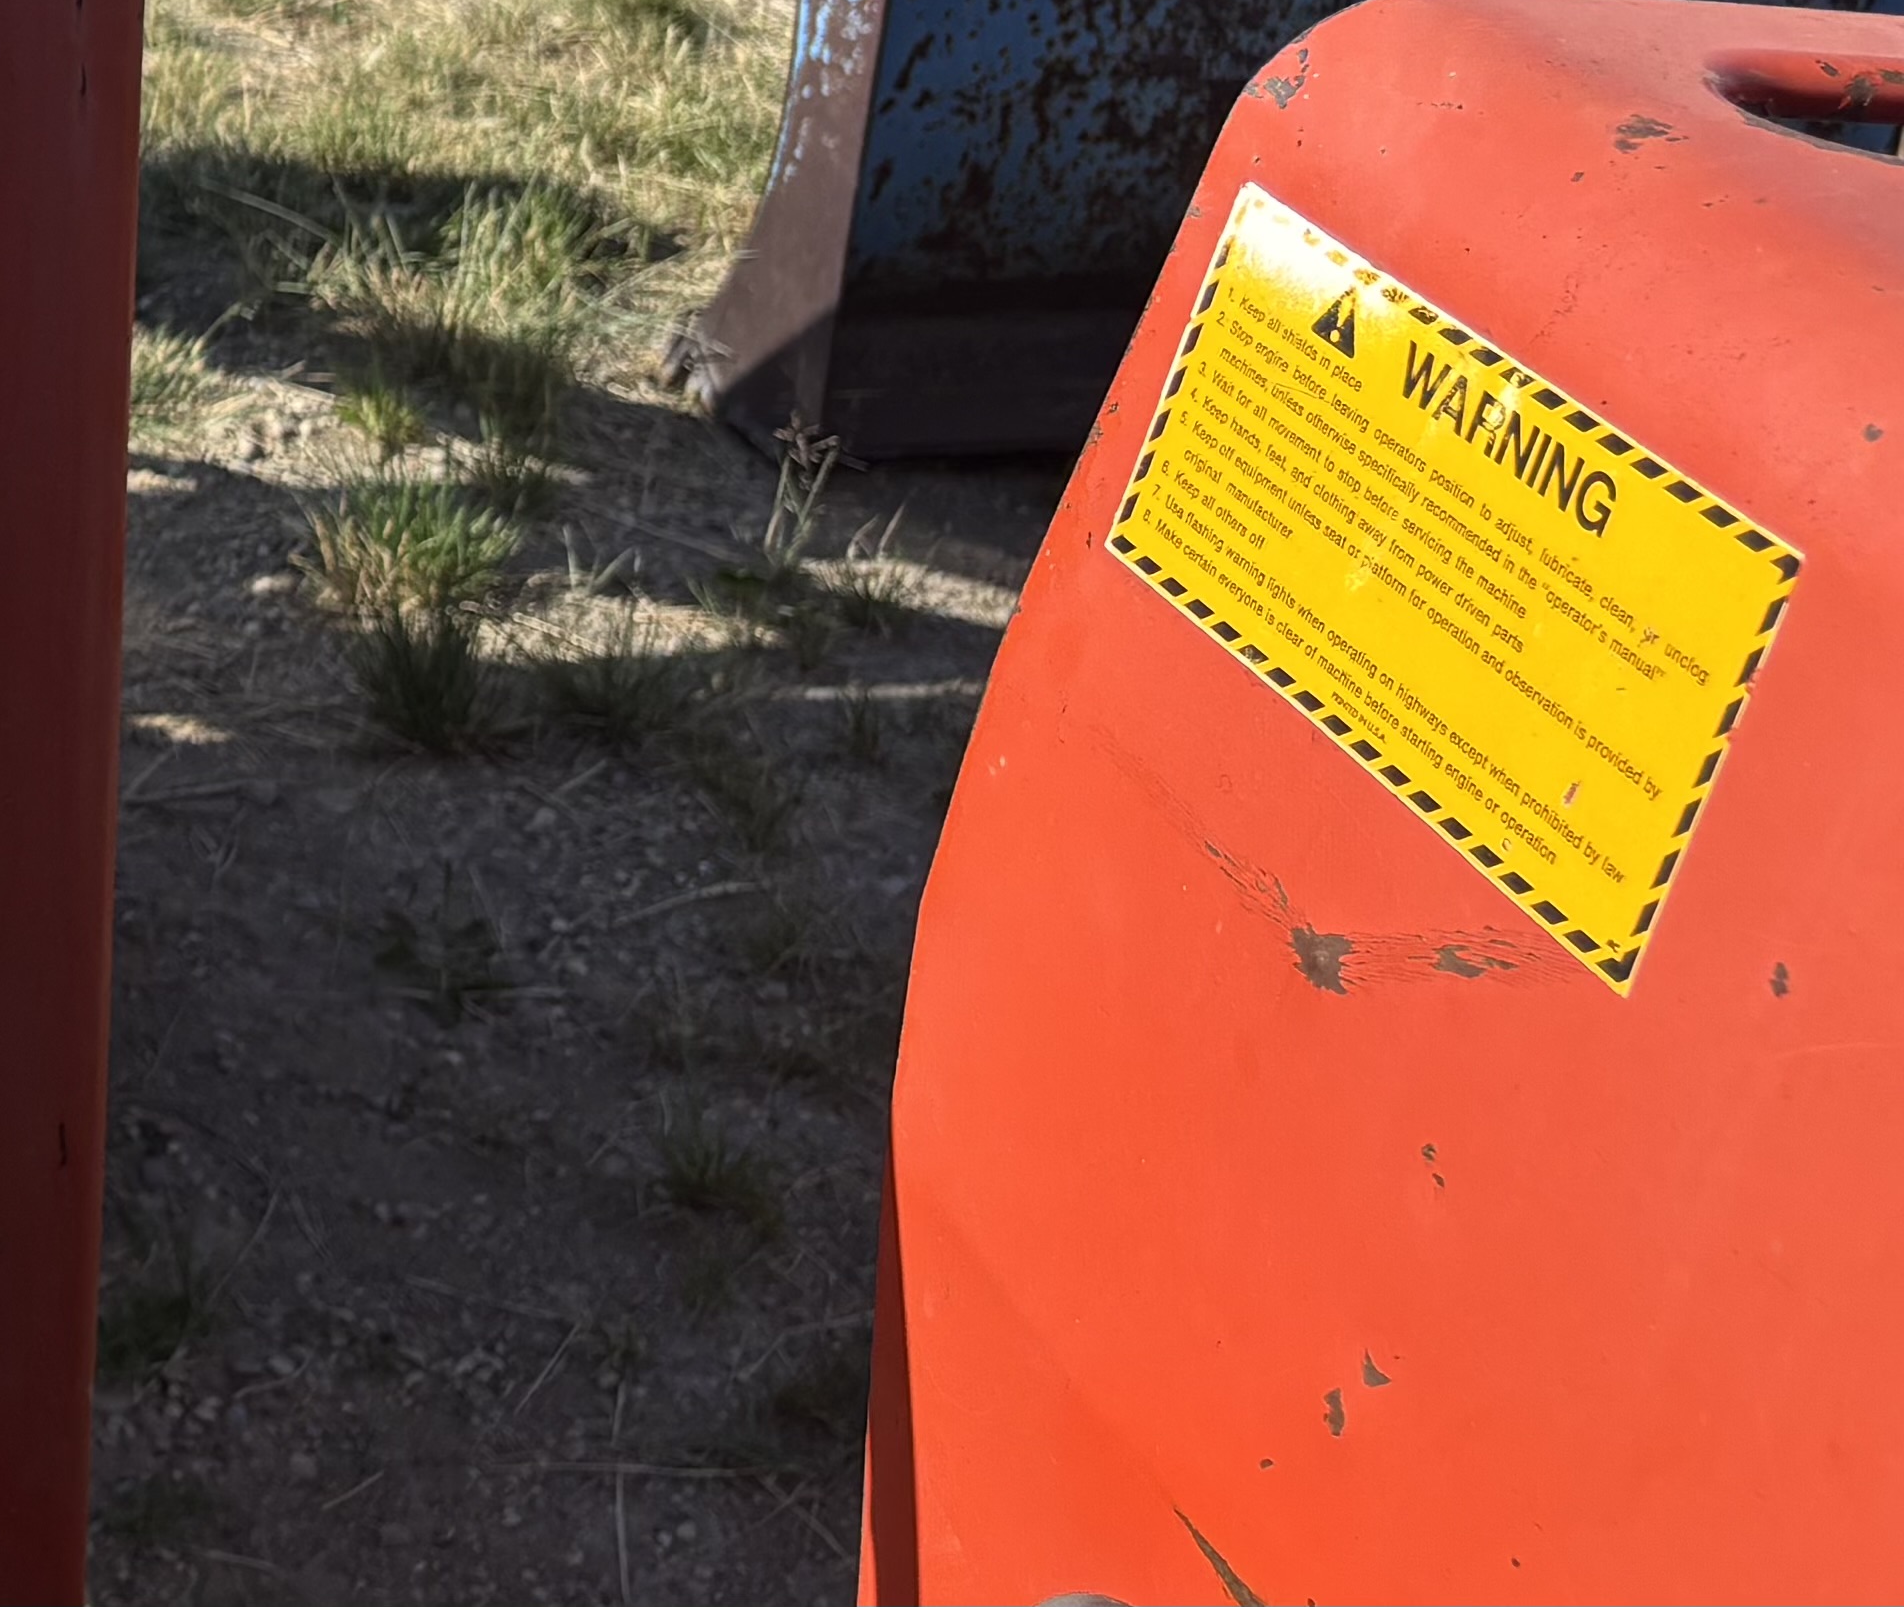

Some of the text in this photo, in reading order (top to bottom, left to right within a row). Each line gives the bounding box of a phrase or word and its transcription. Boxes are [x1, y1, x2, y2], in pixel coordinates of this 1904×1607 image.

[1219, 347, 1538, 590] machines, unless otherwise specifically recommended in the
[1239, 296, 1266, 323] Keep
[1266, 317, 1282, 334] all
[1281, 328, 1319, 362] shields
[1318, 355, 1332, 371] in
[1330, 364, 1363, 393] place
[1401, 339, 1617, 539] WARNING
[1161, 459, 1266, 550] 6. Keep all others off
[1179, 410, 1189, 427] 5.
[1191, 420, 1219, 450] Keep
[1218, 444, 1236, 461] off
[1234, 456, 1288, 504] equipment
[1287, 497, 1323, 531] unless
[1322, 525, 1348, 550] seat
[1407, 588, 1428, 611] for
[1426, 607, 1481, 655] operation
[1480, 650, 1506, 675] and
[1504, 669, 1574, 730] observation
[1573, 720, 1587, 741] is
[1585, 735, 1645, 786] provided
[1642, 776, 1662, 802] by
[1183, 449, 1294, 540] original manufacturer
[1190, 387, 1198, 403] 4.
[1201, 395, 1229, 425] Keep
[1229, 416, 1262, 453] hands,
[1290, 466, 1313, 489] and
[1313, 483, 1357, 525] clothing
[1357, 518, 1388, 548] away
[1388, 538, 1416, 569] from
[1415, 563, 1455, 597] power
[1454, 592, 1491, 627] driven
[1490, 623, 1524, 654] parts
[1211, 369, 1527, 619] Wait for all movement to stop before servicing the machine
[1229, 320, 1710, 687] Stop engine before leaving operators position to adjust, lubricate, clean, unclog
[1142, 508, 1152, 525] 8.
[1154, 518, 1184, 550] Make
[1182, 544, 1218, 578] certain
[1217, 573, 1264, 617] everyone
[1264, 607, 1276, 626] is
[1275, 621, 1305, 648] clear
[1304, 644, 1319, 660] of
[1316, 654, 1363, 699] machine
[1363, 690, 1400, 730] before
[1399, 725, 1444, 770] starting
[1444, 763, 1484, 802] engine
[1500, 811, 1557, 865] operation
[1152, 483, 1625, 883] 7. Use flashing warning lights when operating on highways except when prohibited by law
